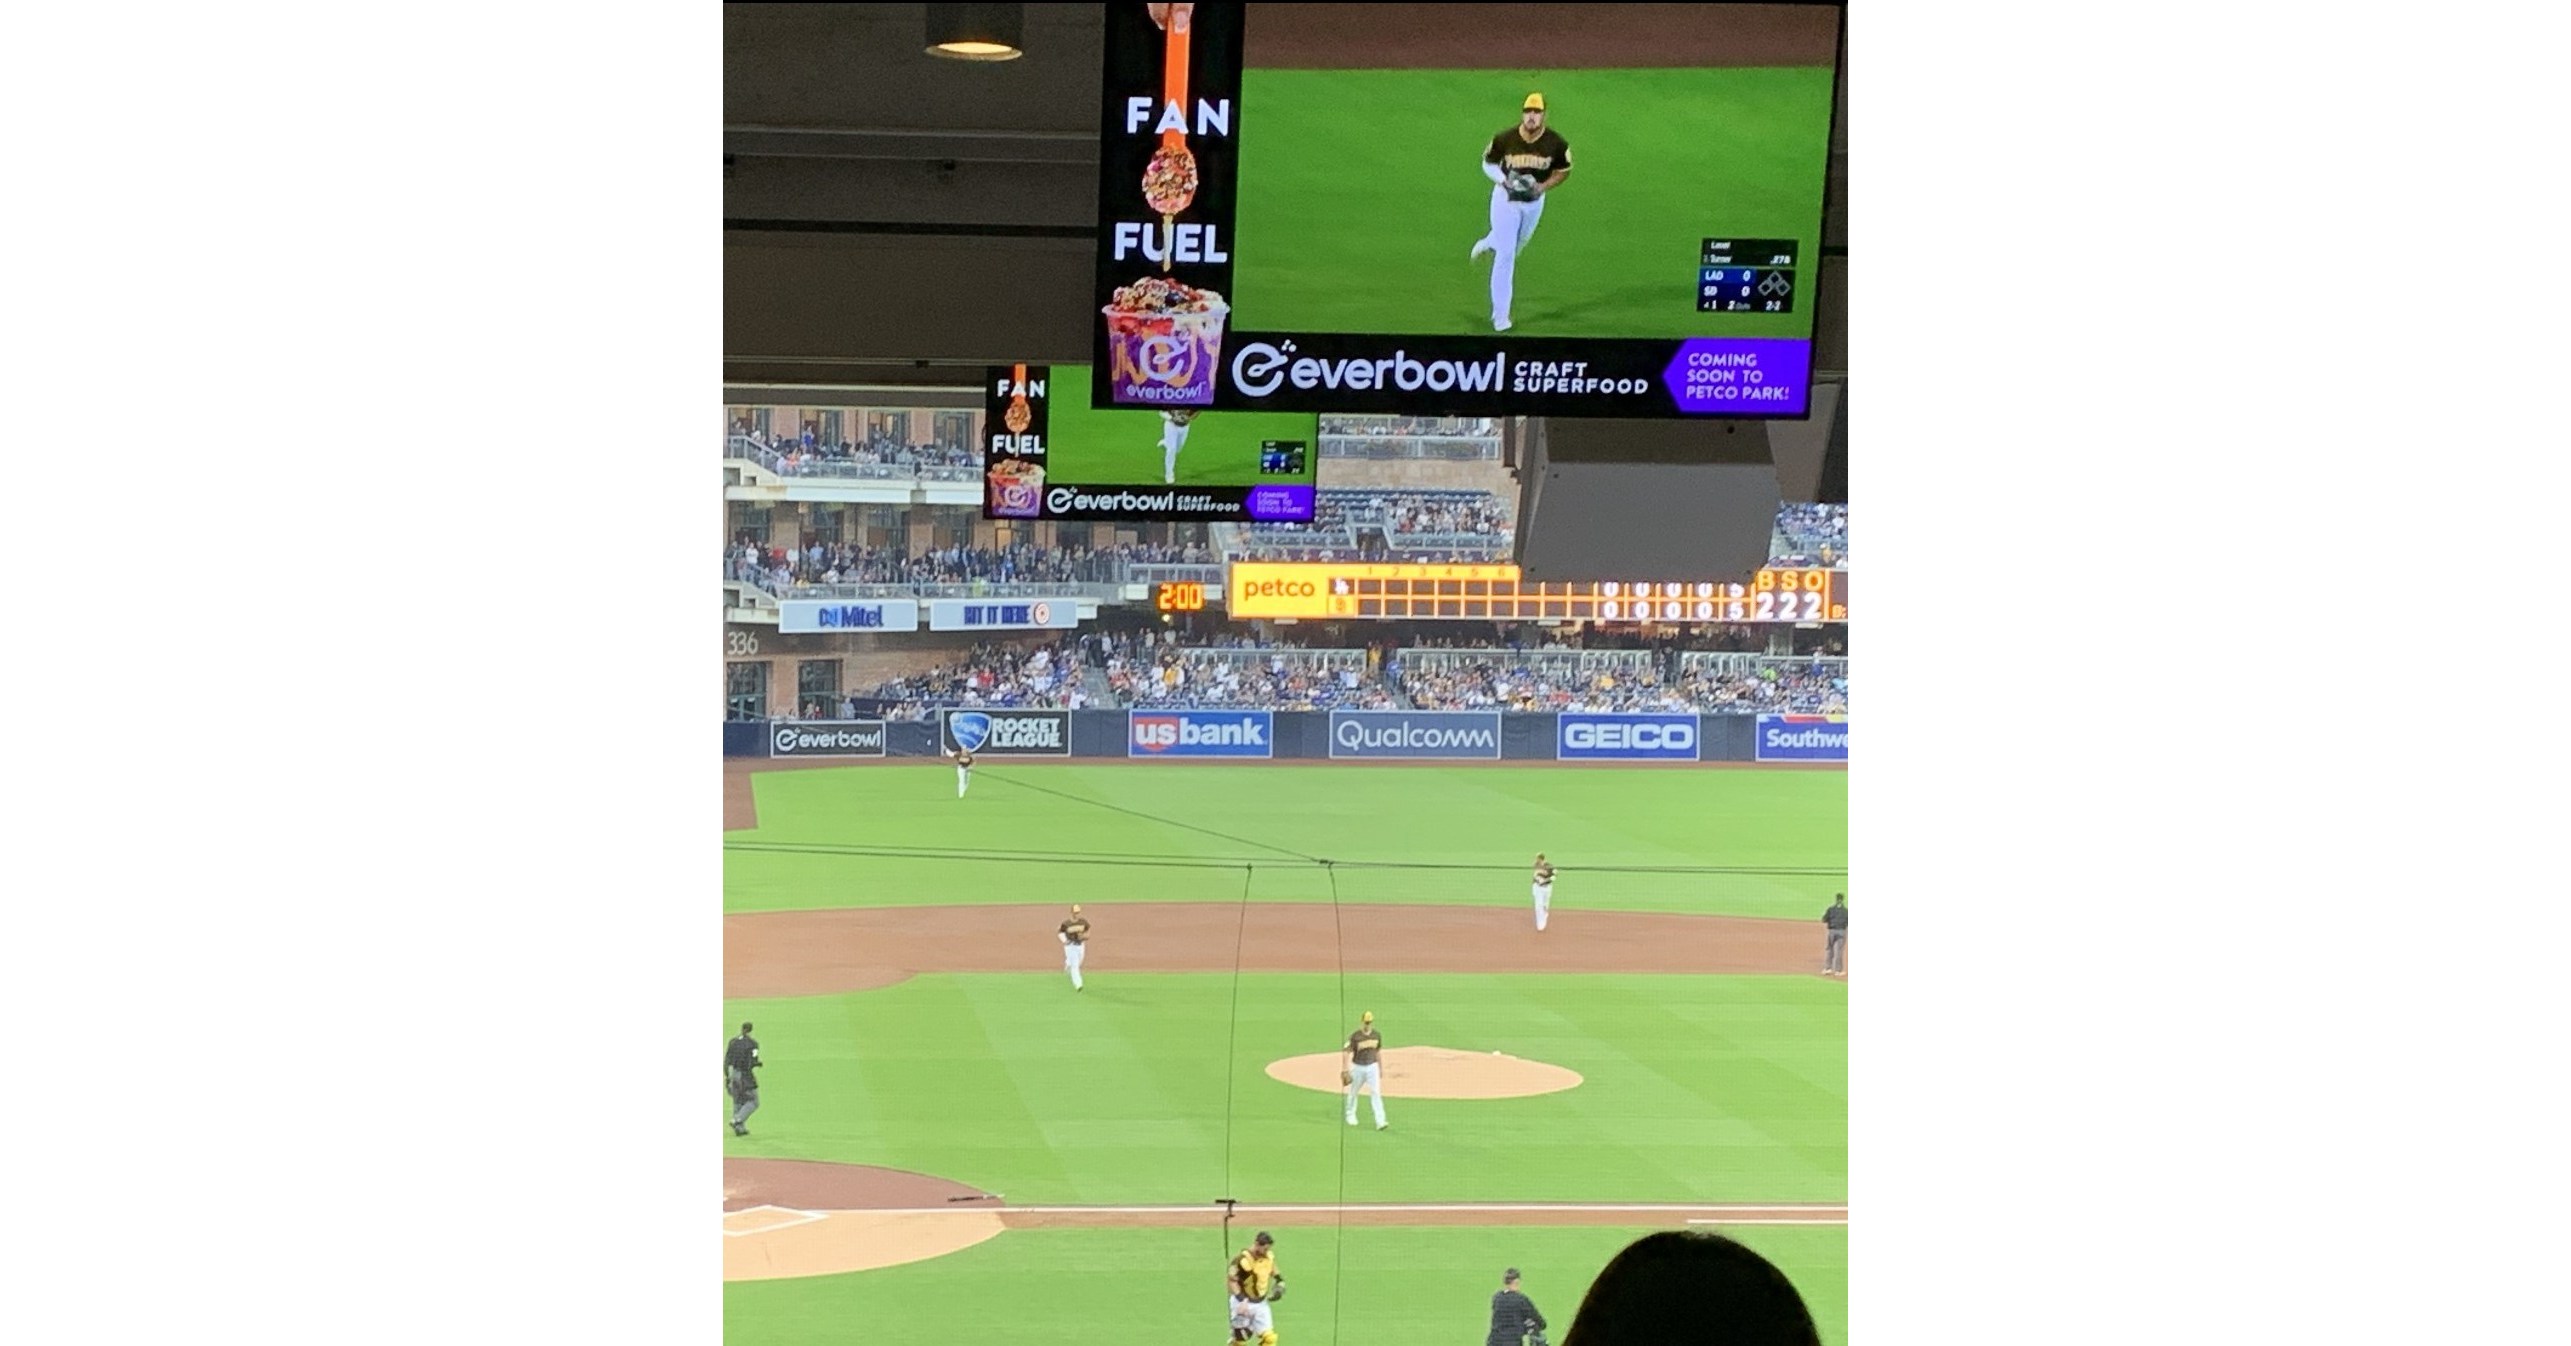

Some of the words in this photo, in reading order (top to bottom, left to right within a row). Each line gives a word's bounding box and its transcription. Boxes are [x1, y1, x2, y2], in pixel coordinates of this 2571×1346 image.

[1127, 96, 1229, 136] FAN
[1114, 222, 1228, 263] FUEL
[1742, 270, 1751, 282] 0
[1741, 286, 1750, 297] 0
[1514, 361, 1588, 378] CRAFT
[1687, 352, 1758, 368] COMING
[1290, 350, 1506, 393] everbowl
[1686, 368, 1736, 383] SOON
[1742, 369, 1764, 384] TO
[996, 379, 1046, 398] FAN
[1126, 381, 1203, 400] everbowl
[1513, 377, 1649, 395] SUPERFOOD
[1686, 385, 1739, 400] PETCO
[1742, 385, 1790, 401] PARK!
[992, 434, 1046, 455] FUEL
[1074, 490, 1174, 512] everbowl
[1176, 503, 1241, 512] SUPERFOOD
[1244, 578, 1315, 600] petco
[1757, 571, 1775, 591] B
[1780, 571, 1798, 591] S
[1804, 571, 1824, 591] O
[1160, 583, 1202, 610] 2:00
[1757, 592, 1774, 620] 2
[1780, 592, 1798, 620] 2
[1804, 592, 1822, 620] 2
[841, 605, 884, 628] Mitel
[1603, 602, 1619, 620] 0
[1634, 602, 1649, 620] 0
[1666, 602, 1682, 620] 0
[1697, 602, 1713, 620] 0
[1729, 602, 1744, 620] 5
[727, 631, 759, 656] 336
[991, 718, 1060, 733] ROCKET
[1337, 720, 1494, 750] Qualcomm
[799, 729, 882, 747] everbowl
[991, 733, 1060, 748] LEAGUE
[1565, 723, 1694, 749] GEICO
